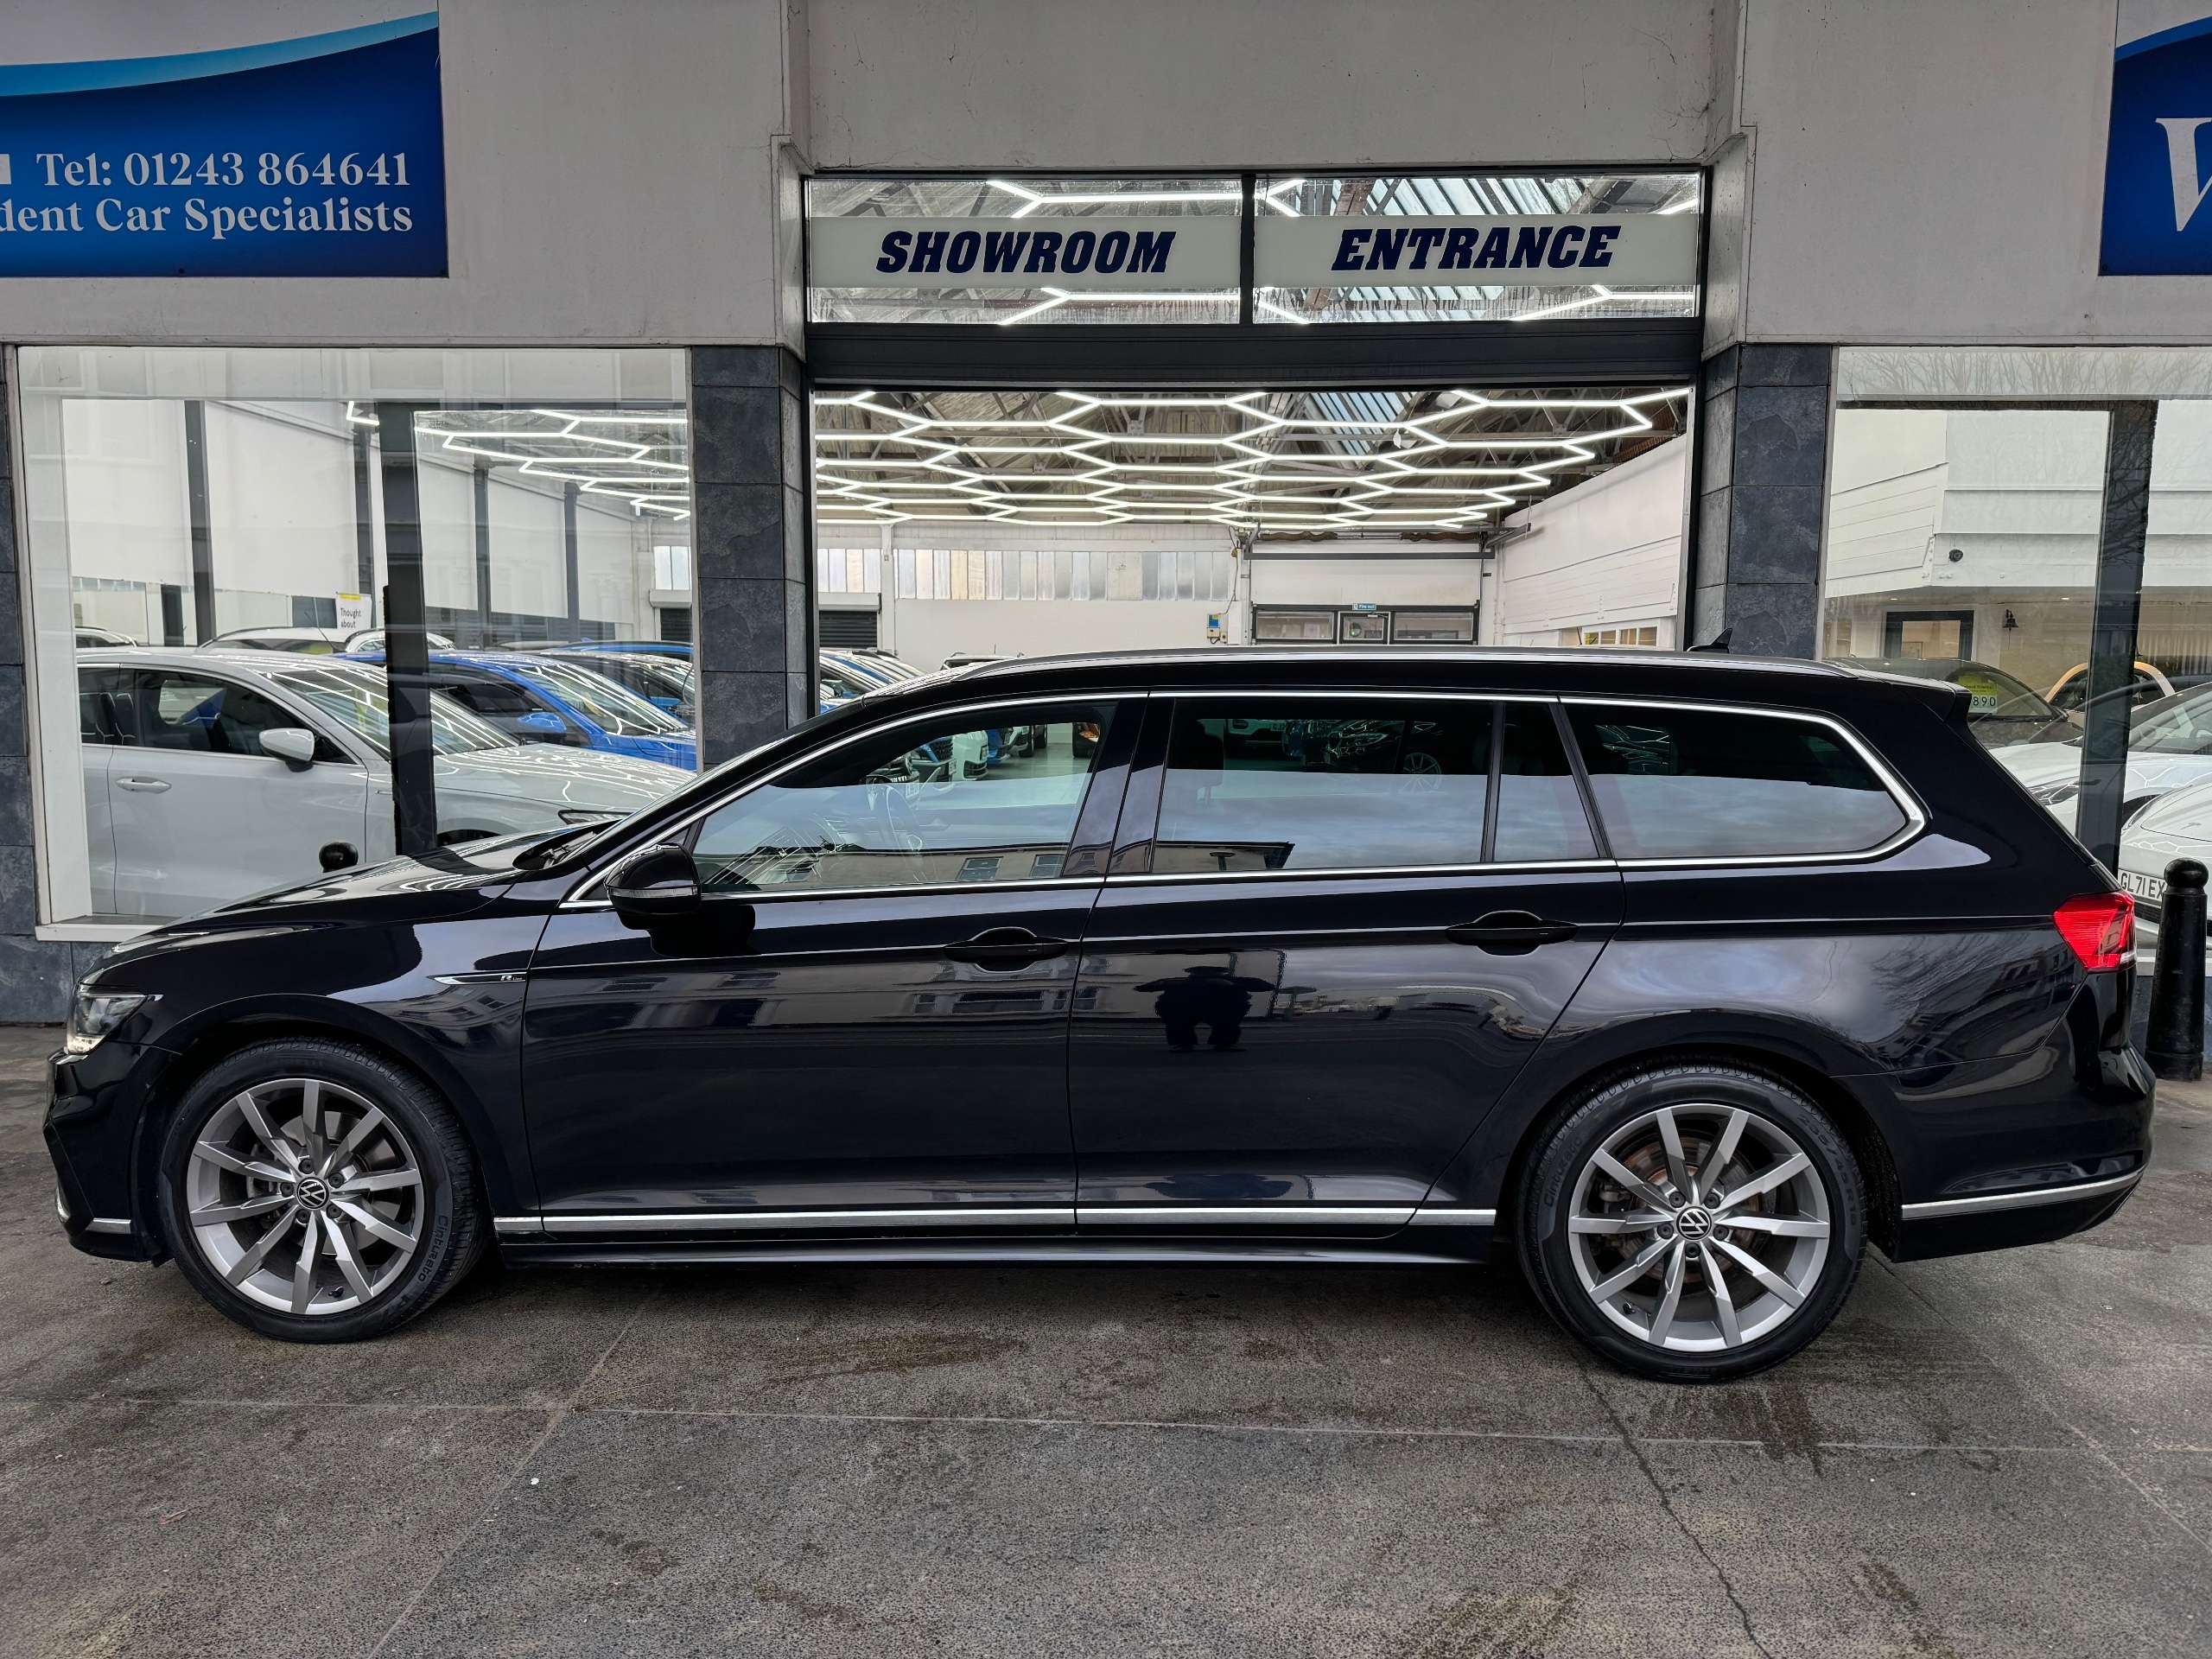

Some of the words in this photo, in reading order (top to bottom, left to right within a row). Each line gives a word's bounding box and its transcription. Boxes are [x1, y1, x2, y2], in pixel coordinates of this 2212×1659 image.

[36, 153, 111, 187] Tel:
[124, 152, 245, 187] 01243
[257, 152, 410, 187] 864641
[0, 198, 84, 232] dent
[96, 198, 171, 232] Car
[184, 196, 413, 239] Specialists
[875, 230, 1177, 274] SHOWROOM
[1331, 225, 1622, 270] ENTRANCE
[340, 607, 361, 620] Thought
[340, 619, 356, 629] about
